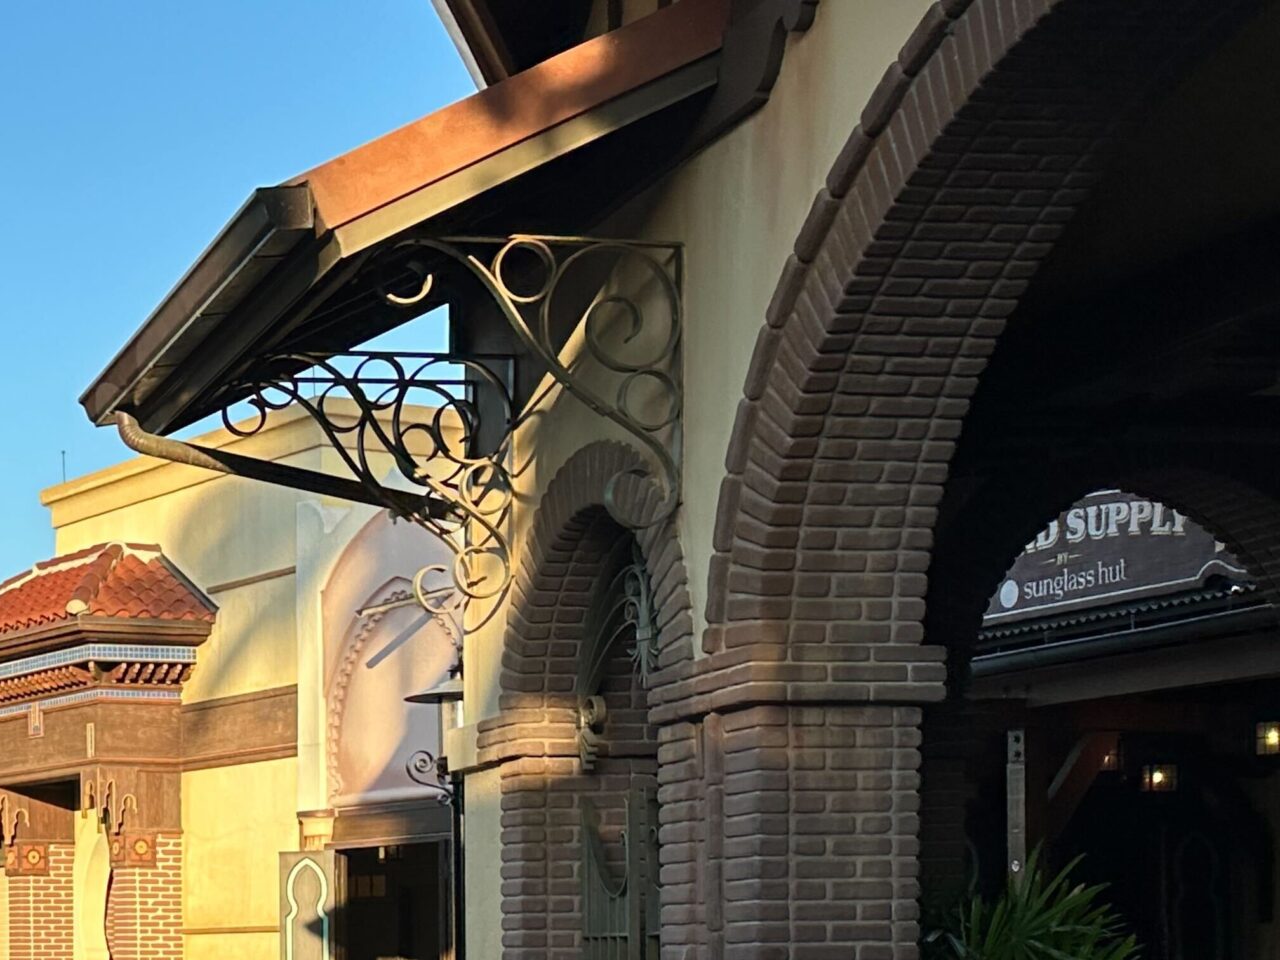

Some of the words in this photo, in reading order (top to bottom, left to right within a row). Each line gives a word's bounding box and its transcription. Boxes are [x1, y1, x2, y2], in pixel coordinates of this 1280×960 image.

[1066, 501, 1187, 543] SUPPLY
[1023, 567, 1095, 600] sunglass
[1098, 558, 1127, 585] hut
